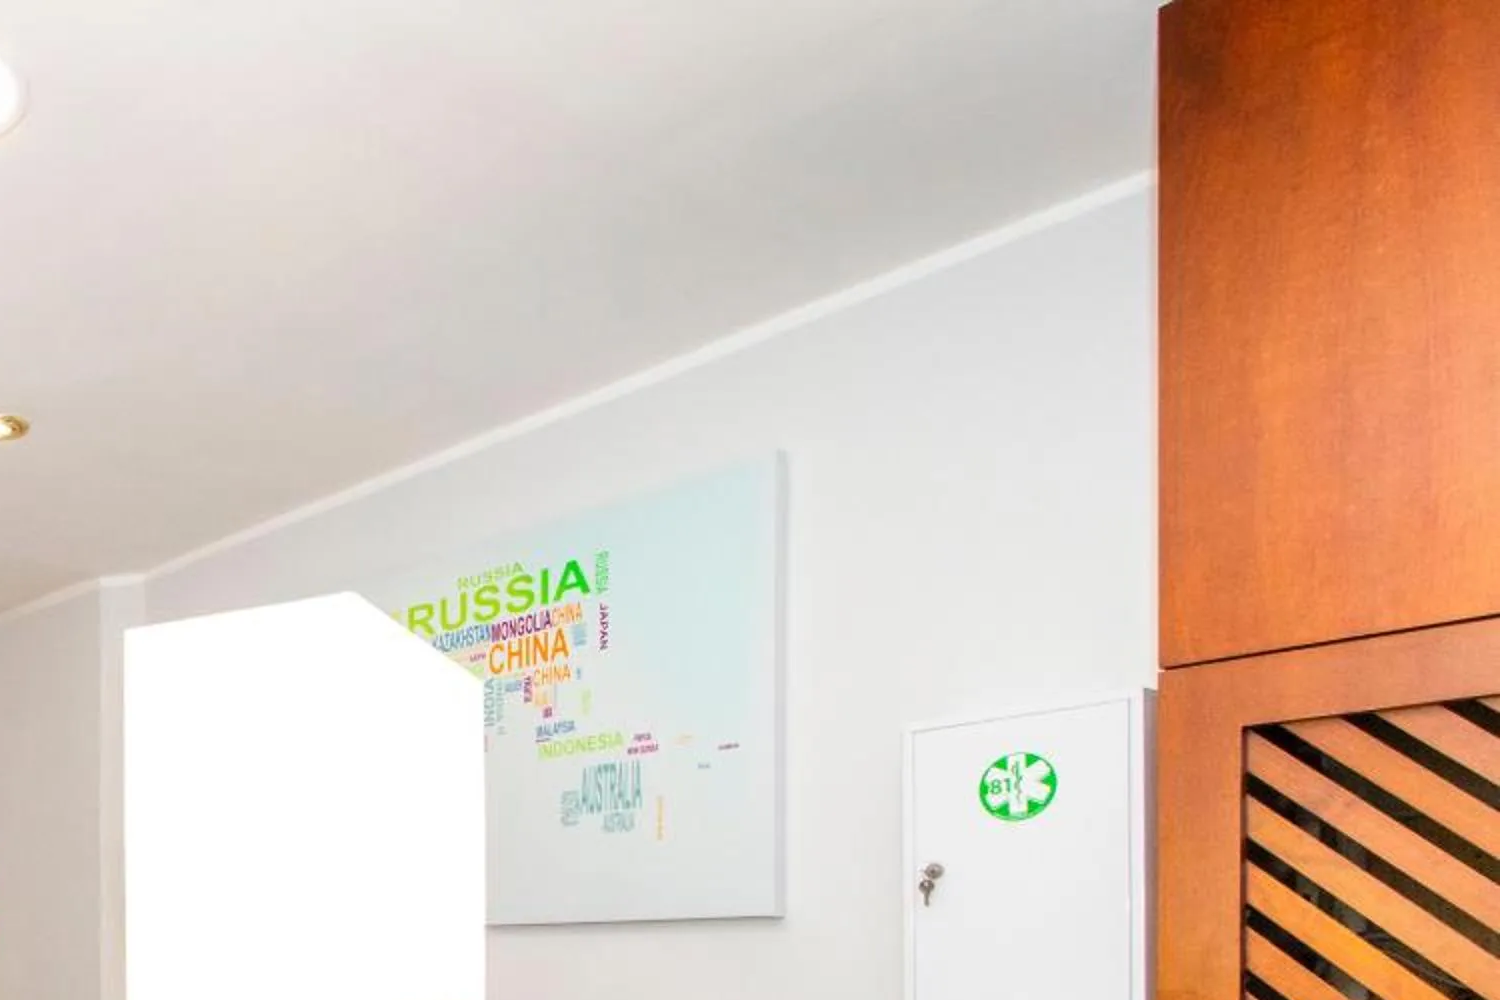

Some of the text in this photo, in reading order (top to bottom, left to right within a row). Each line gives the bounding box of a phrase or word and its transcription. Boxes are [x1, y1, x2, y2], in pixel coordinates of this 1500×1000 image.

[457, 562, 524, 590] RUSSIA
[407, 559, 590, 638] RUSSIA
[491, 610, 552, 642] MONGOLIA
[551, 602, 583, 628] CHINA
[599, 602, 609, 650] JAPAN
[488, 627, 570, 674] CHINA
[533, 664, 571, 687] CHINA
[537, 731, 624, 761] INDONESIA
[581, 760, 642, 815] AUSTRALIA
[989, 777, 1012, 795] 81
